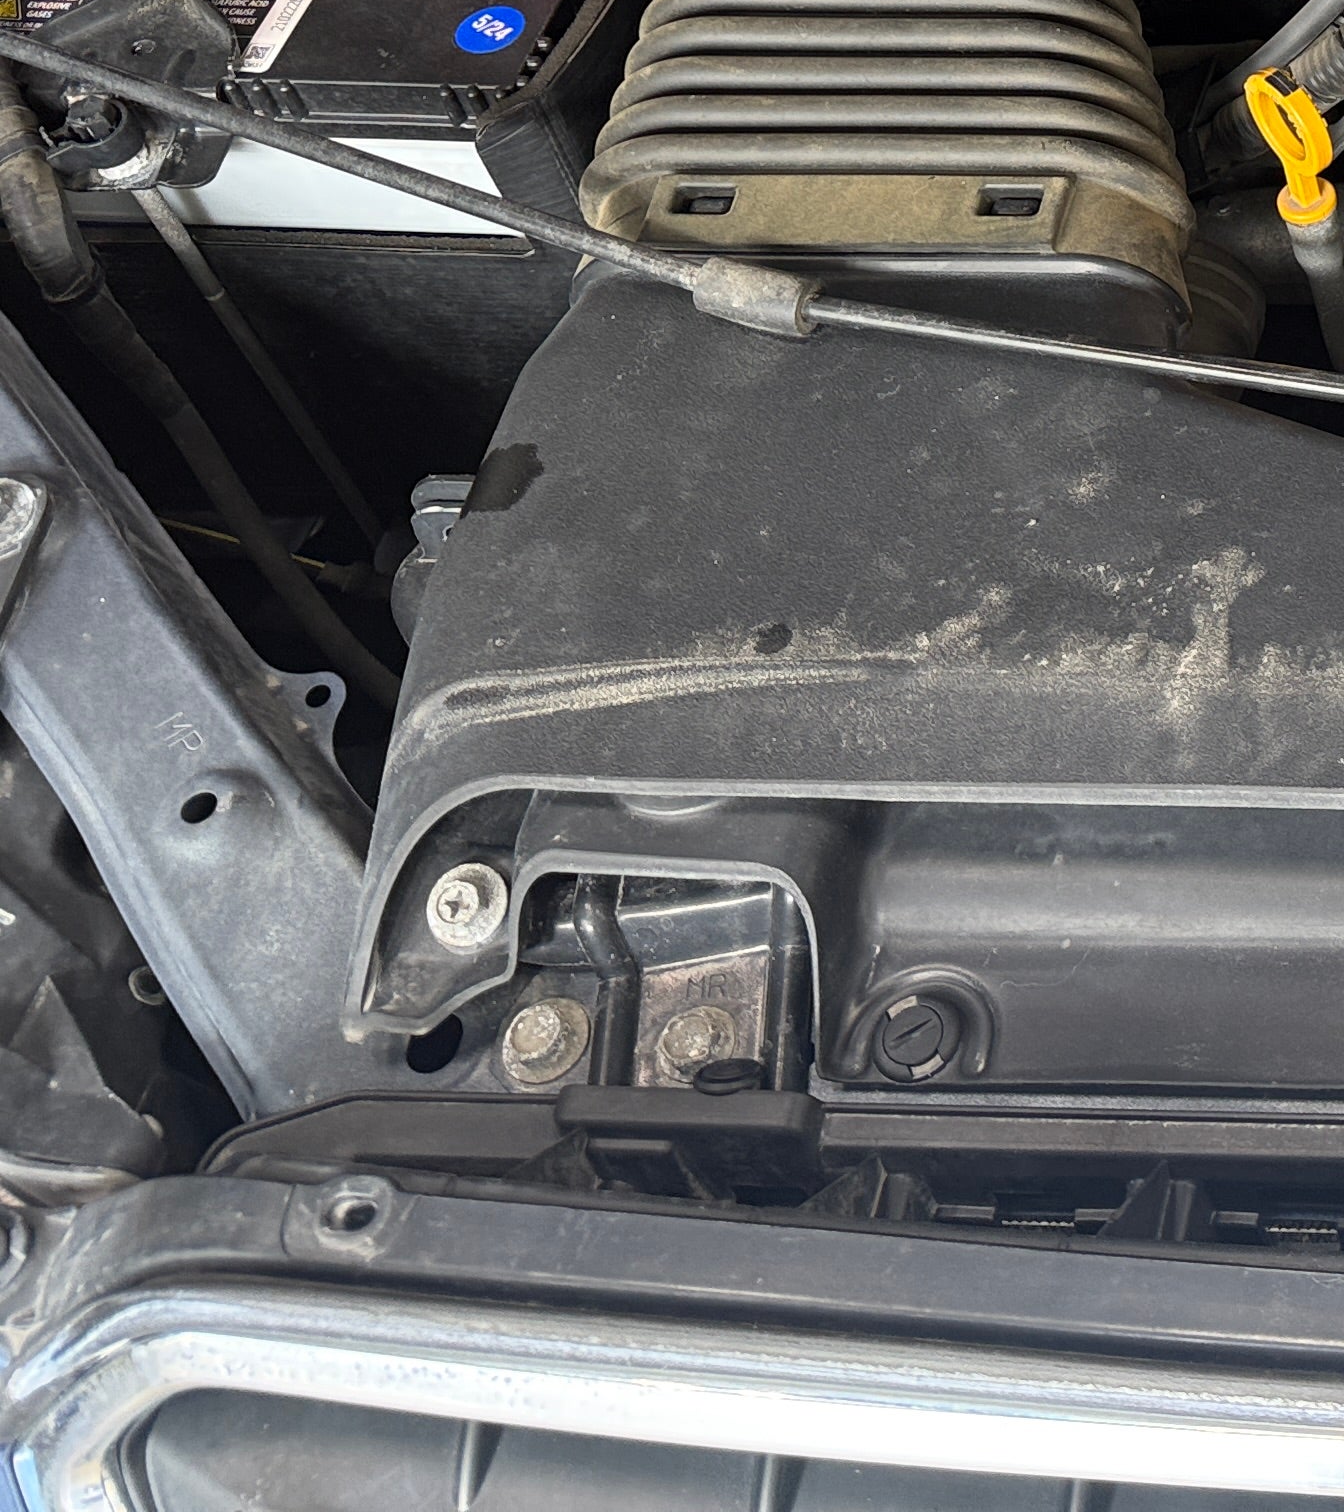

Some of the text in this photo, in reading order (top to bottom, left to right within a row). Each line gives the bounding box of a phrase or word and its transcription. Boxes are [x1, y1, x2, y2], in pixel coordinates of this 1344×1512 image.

[27, 1, 72, 11] EXPLOSIVE
[249, 0, 271, 8] ACID
[26, 10, 54, 19] GASES
[229, 8, 257, 16] CAUSE
[472, 14, 515, 41] 5/24
[685, 973, 728, 1001] MR
